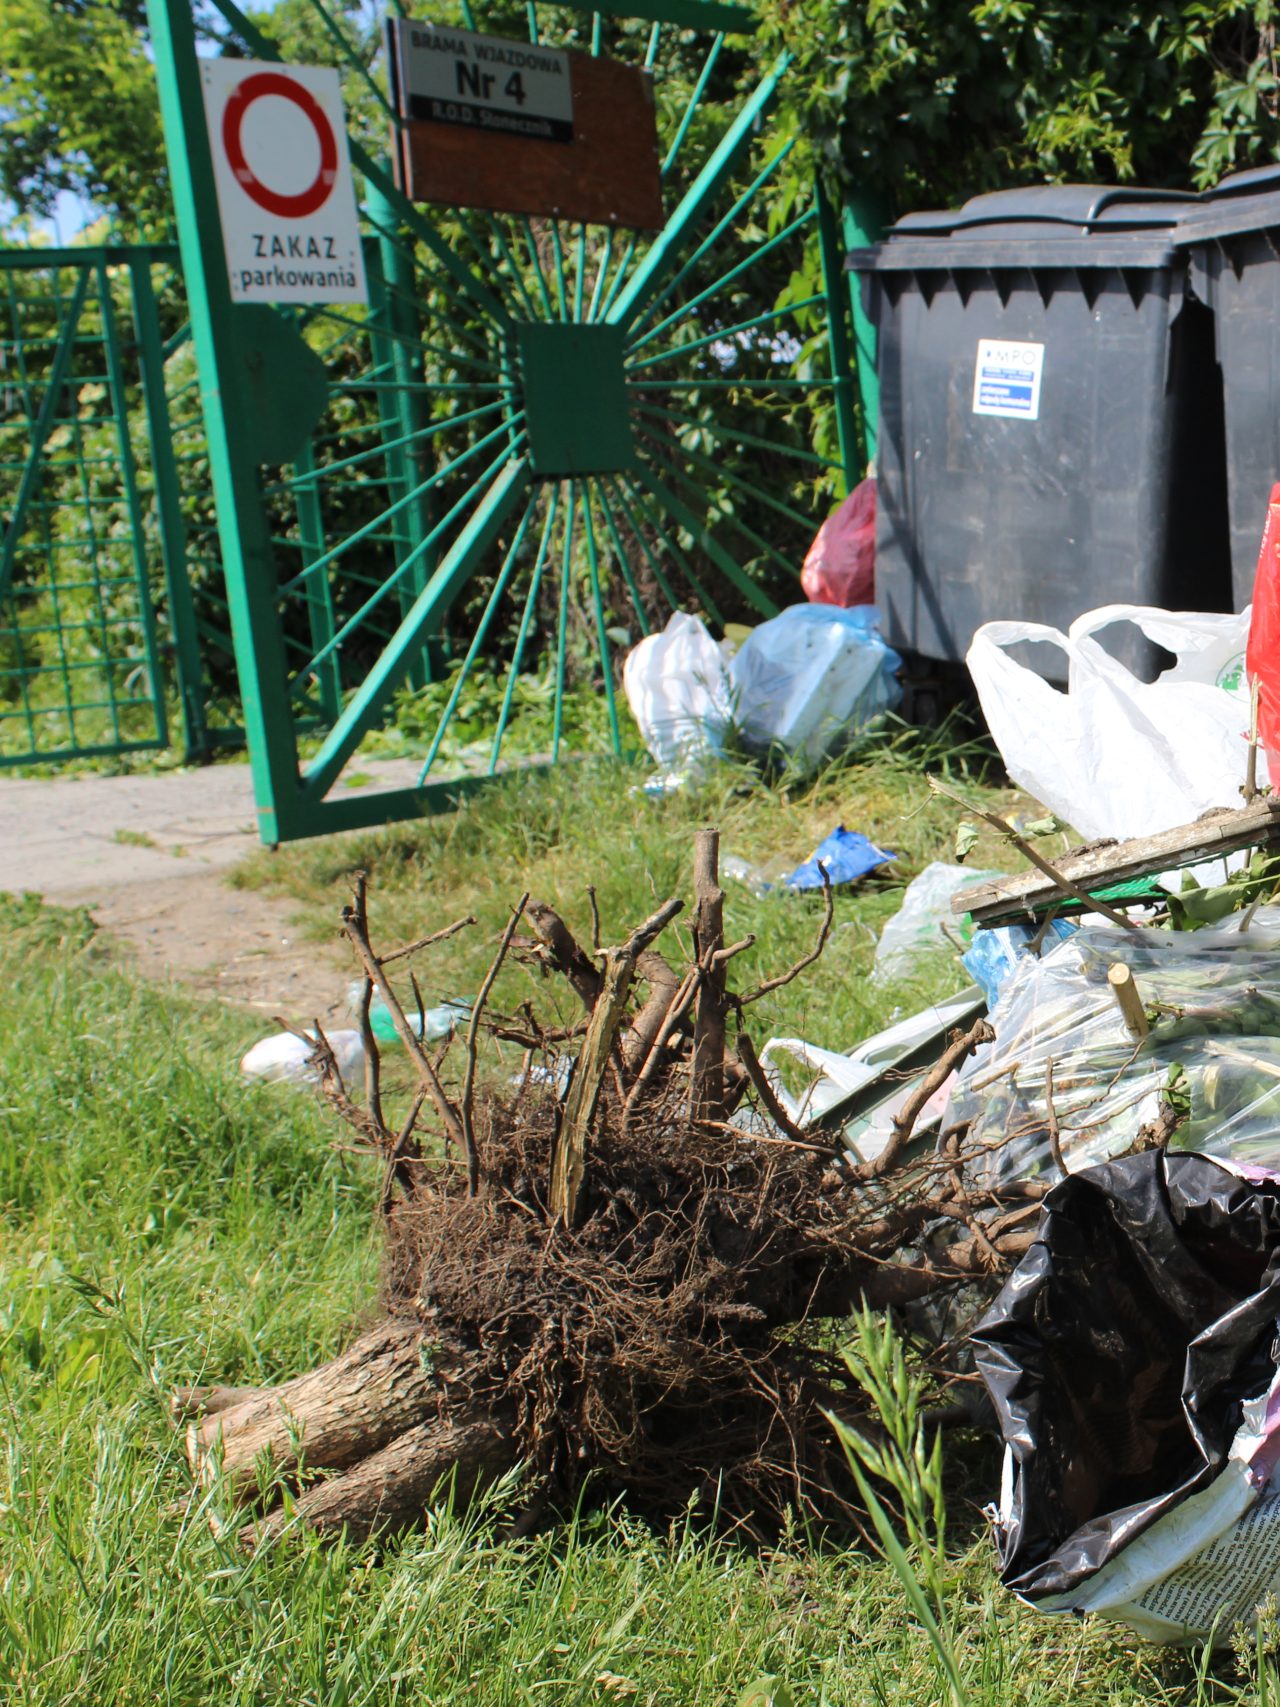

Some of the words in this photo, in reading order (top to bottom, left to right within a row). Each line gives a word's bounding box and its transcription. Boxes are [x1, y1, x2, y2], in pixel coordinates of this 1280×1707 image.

[410, 30, 468, 57] BRAMA
[474, 44, 563, 74] WJAZDOWA
[455, 60, 496, 99] Nr
[505, 70, 526, 106] 4
[252, 235, 337, 259] ZAKAZ
[241, 264, 356, 292] parkowania
